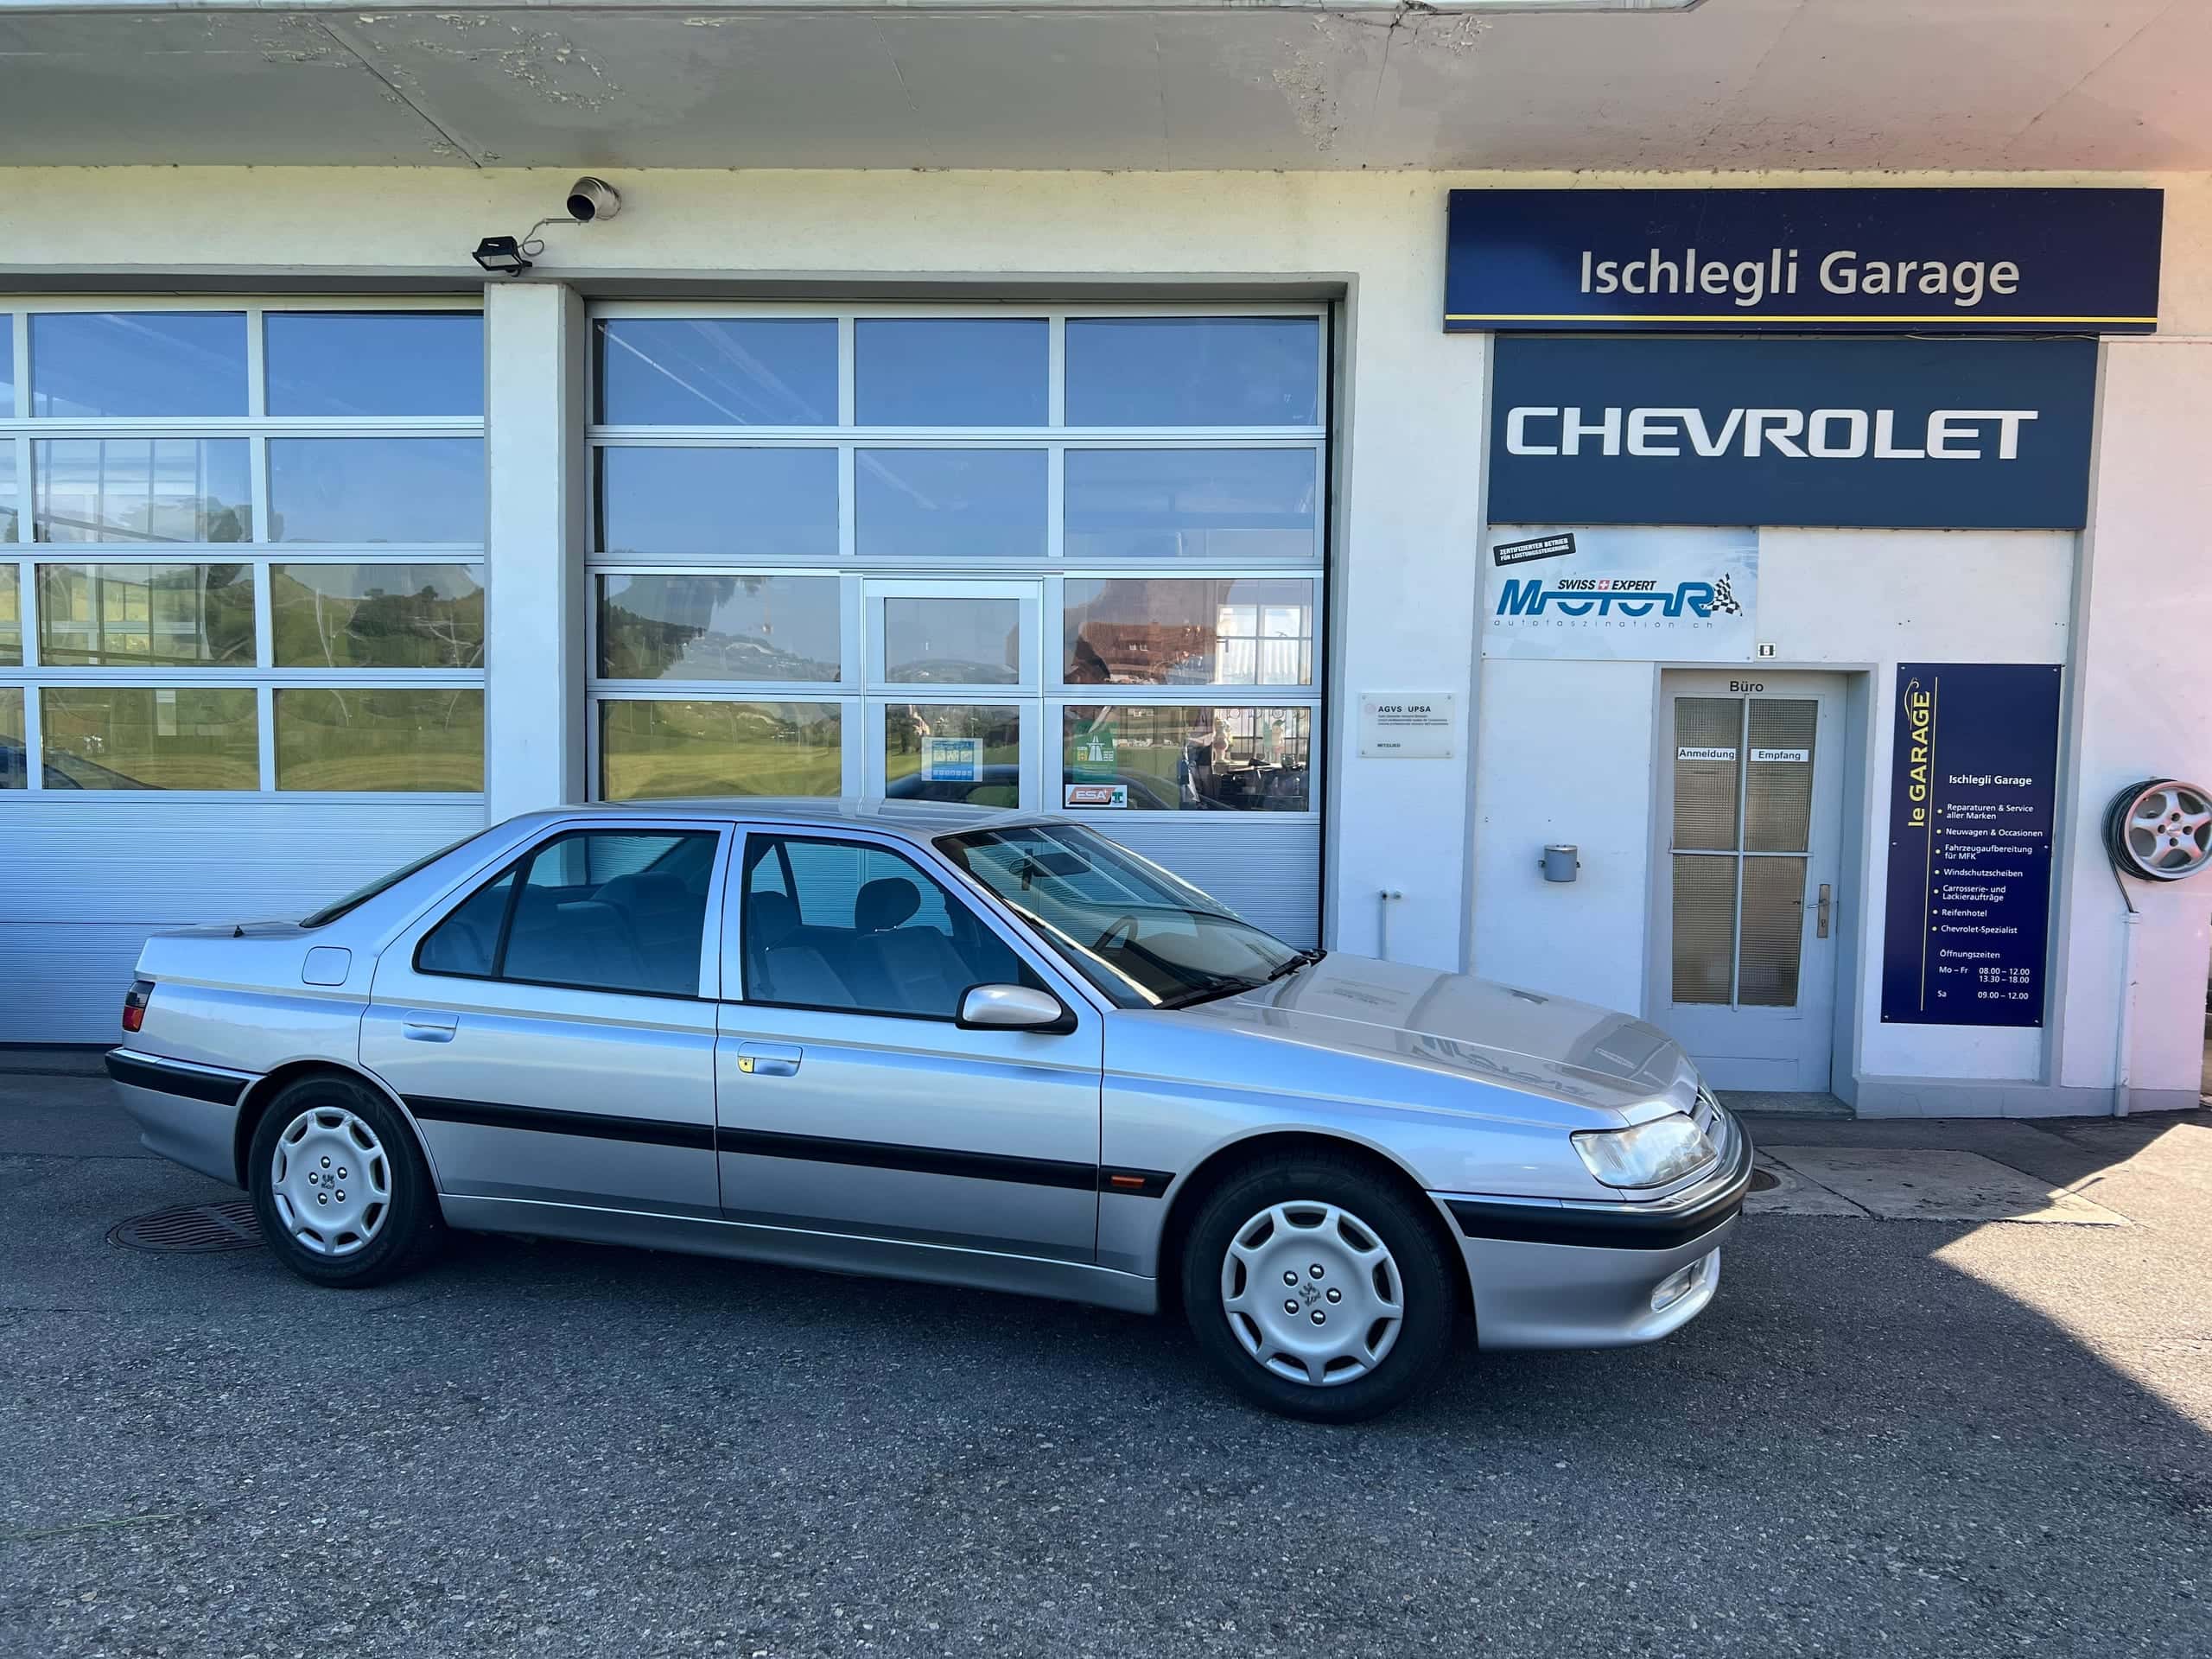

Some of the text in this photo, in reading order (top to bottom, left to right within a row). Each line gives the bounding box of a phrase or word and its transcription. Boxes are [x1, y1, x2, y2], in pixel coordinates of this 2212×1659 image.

[1580, 249, 2020, 307] Ischlegli Garage
[1506, 406, 2039, 461] CHEVROLET
[1499, 537, 1568, 556] ZERTIFIZIERTER BETRIEB
[1500, 553, 1511, 562] FÜR
[1557, 579, 1657, 591] SWISS EXPERT
[1494, 619, 1713, 629] autofaszinationch
[1729, 681, 1764, 692] Büro
[1679, 748, 1735, 760] Anmeldung
[1758, 751, 1801, 760] Empfang
[1907, 690, 1930, 827] le GARAGE
[1948, 775, 2032, 786] Ischlegli Garage
[1947, 804, 1996, 812] Reparaturen
[1945, 828, 1988, 837] Neuwagen
[1998, 829, 2044, 837] Occasionen
[1944, 844, 2033, 855] Fahrzeugaufbereitung
[1944, 852, 1977, 861] für MFK
[1943, 868, 2024, 878] Windschutzscheiben
[1942, 893, 2004, 903] Lackieraufträge
[1942, 908, 1987, 918] Reifenhotel
[1941, 925, 2018, 935] Chevrolet-Spezialist
[1939, 949, 2000, 959] Öffnungszeiten
[1938, 966, 1953, 975] Mo
[1960, 966, 1968, 975] Fr
